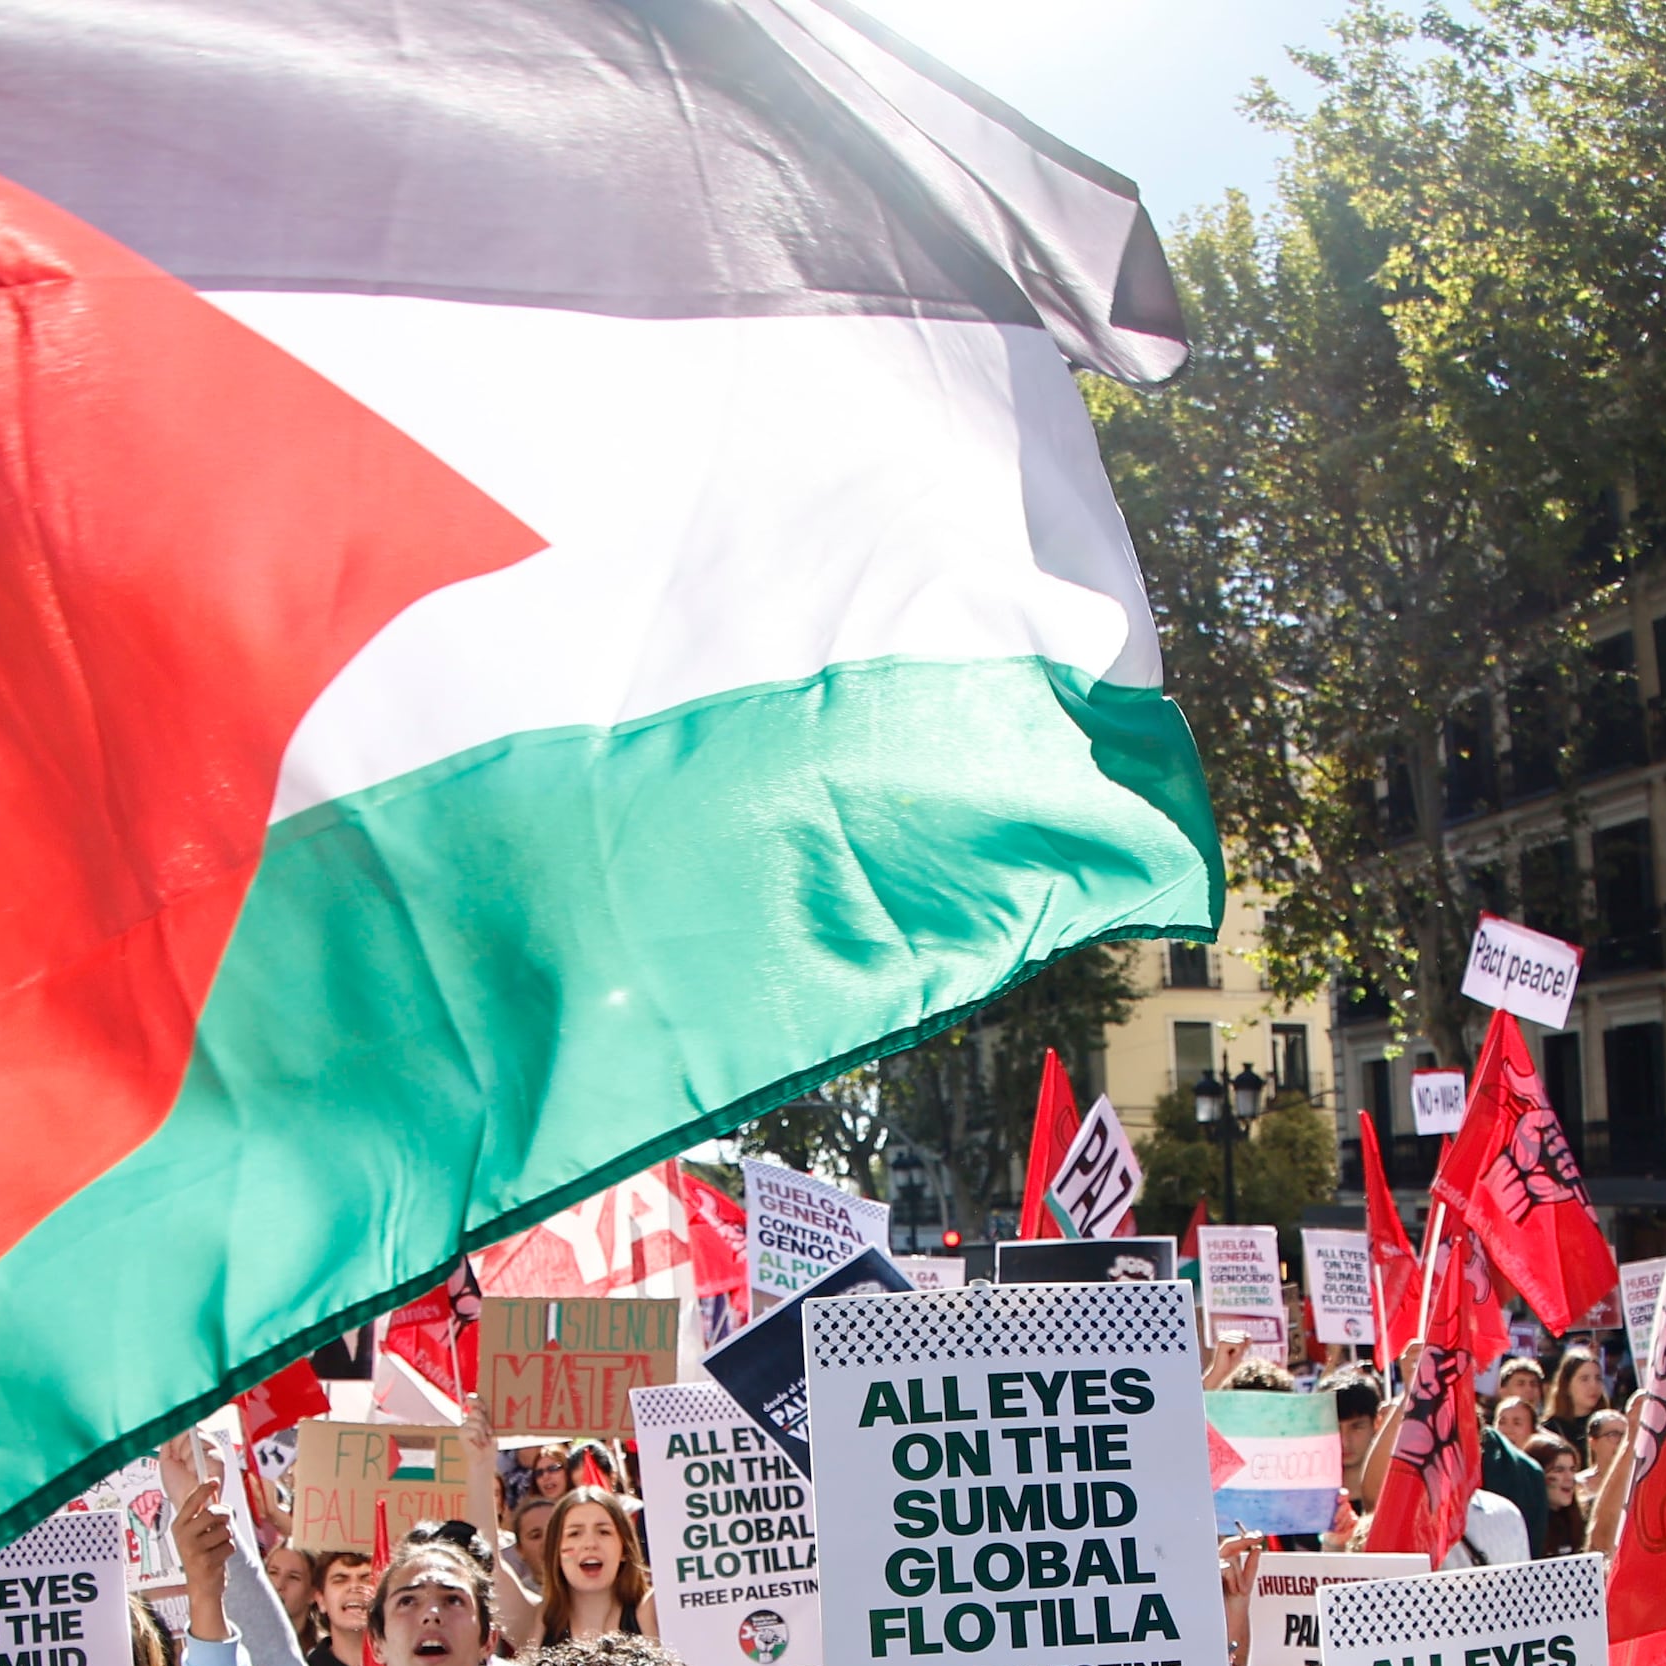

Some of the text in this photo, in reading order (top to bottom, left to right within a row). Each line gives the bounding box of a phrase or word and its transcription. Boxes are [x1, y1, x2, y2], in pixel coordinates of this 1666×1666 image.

[1473, 929, 1573, 1001] Pact peace!
[755, 1177, 852, 1225] HUELGA
[759, 1195, 868, 1245] GENERAL
[758, 1214, 833, 1251] CONTRA
[758, 1229, 847, 1266] GENOC
[500, 1300, 543, 1351] TU
[563, 1300, 679, 1352] SILENCIO
[492, 1353, 657, 1432] MATA
[857, 1375, 977, 1429] ALL
[986, 1368, 1156, 1420] EYES
[665, 1427, 769, 1461] ALL EY
[891, 1424, 1132, 1481] ON THE
[683, 1458, 734, 1488] ON
[685, 1485, 805, 1520] SUMUD
[892, 1480, 1139, 1541] SUMUD
[683, 1514, 815, 1551] GLOBAL
[884, 1536, 1157, 1599] GLOBAL
[680, 1578, 820, 1609] FREE PALESTIN
[4, 1608, 84, 1646] THE
[868, 1593, 1181, 1659] FLOTILLA
